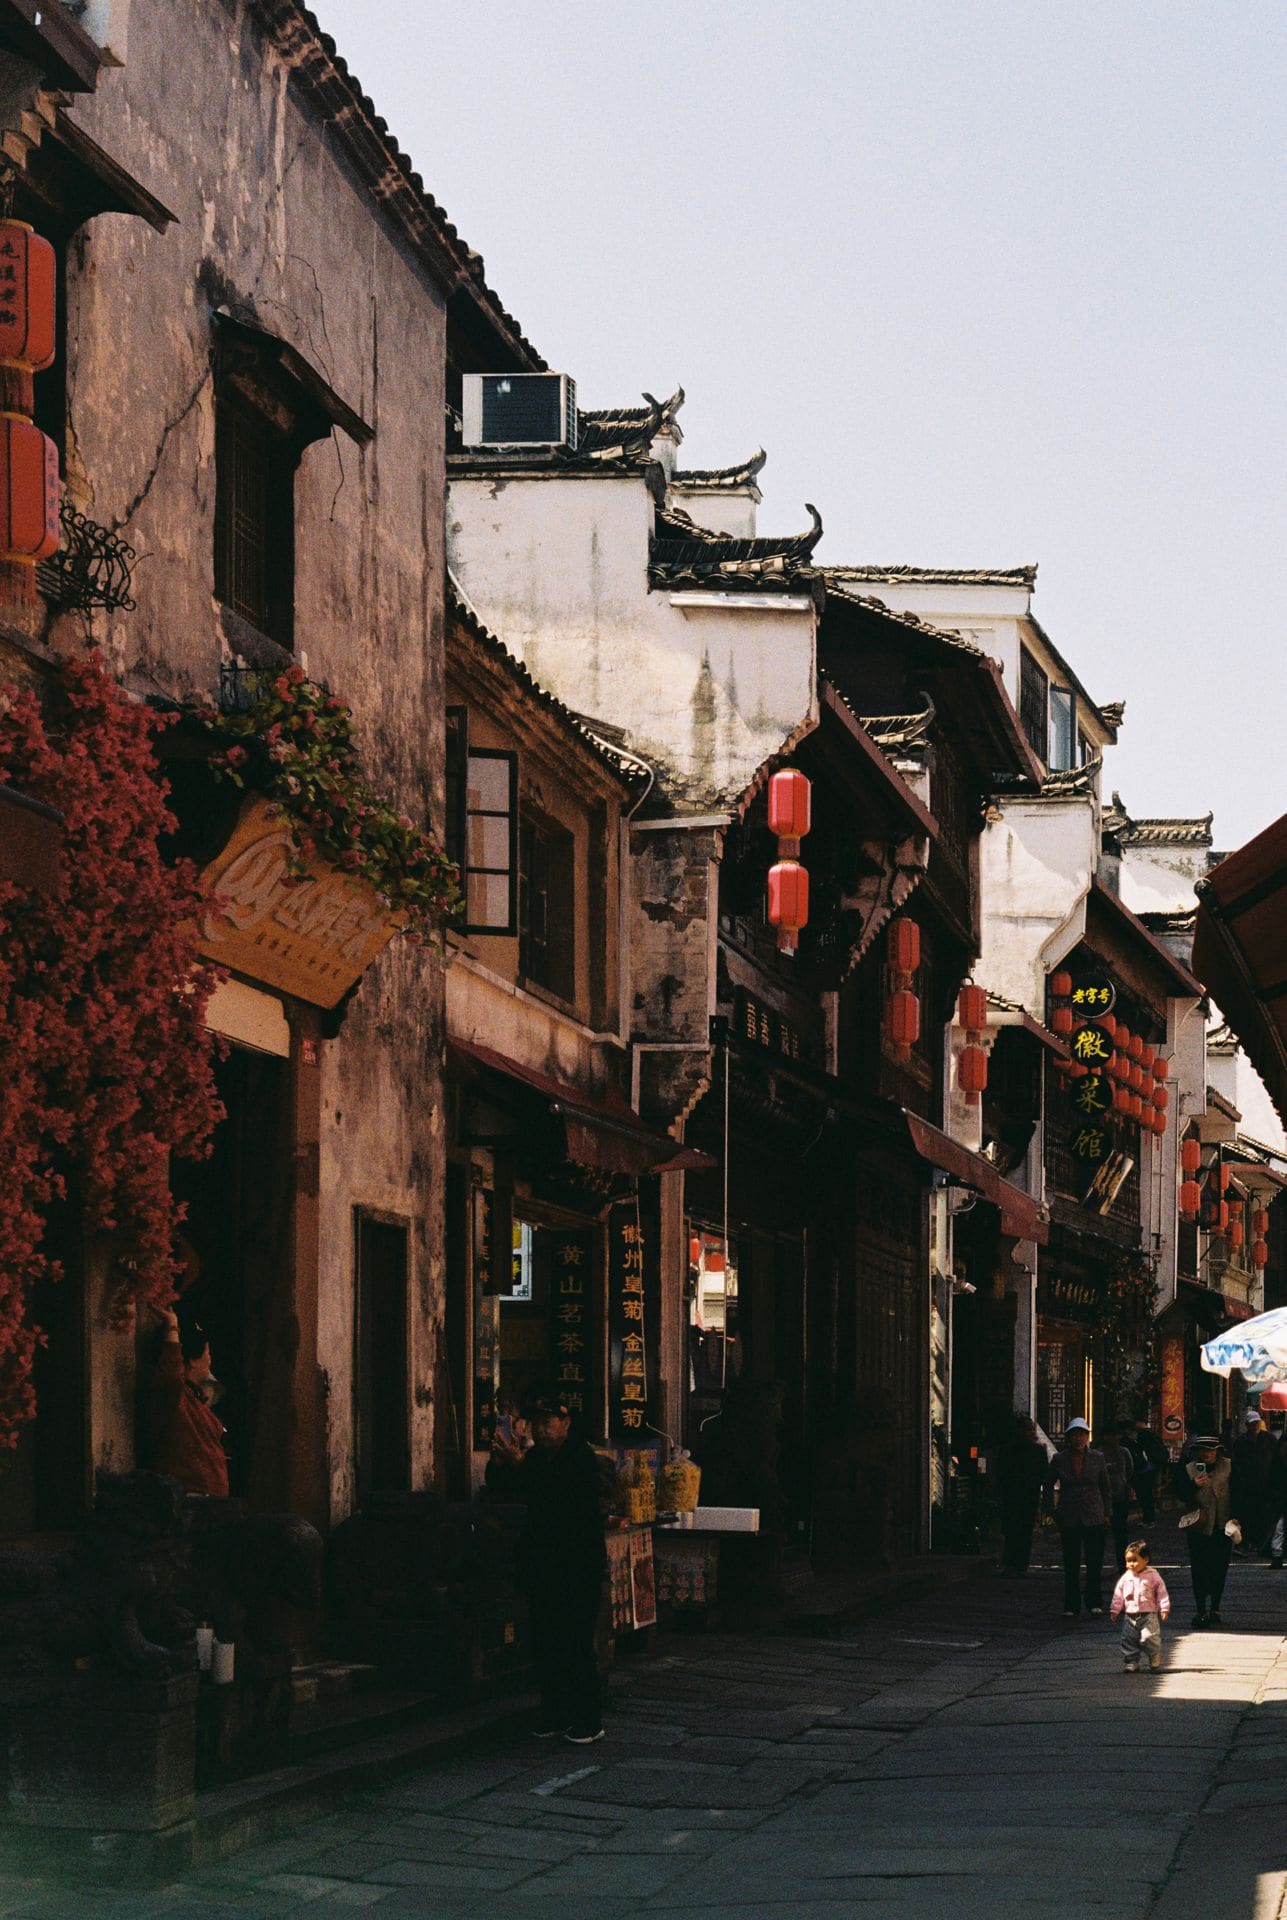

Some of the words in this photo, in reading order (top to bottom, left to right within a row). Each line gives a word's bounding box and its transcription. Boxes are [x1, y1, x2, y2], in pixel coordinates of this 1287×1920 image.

[1071, 988, 1111, 1005] 老字号
[1072, 1030, 1109, 1158] 徽菜馆
[621, 1223, 645, 1321] 徽州皇菊
[558, 1243, 584, 1412] 黄山茗茶直销
[620, 1331, 645, 1429] 金丝皇菊
